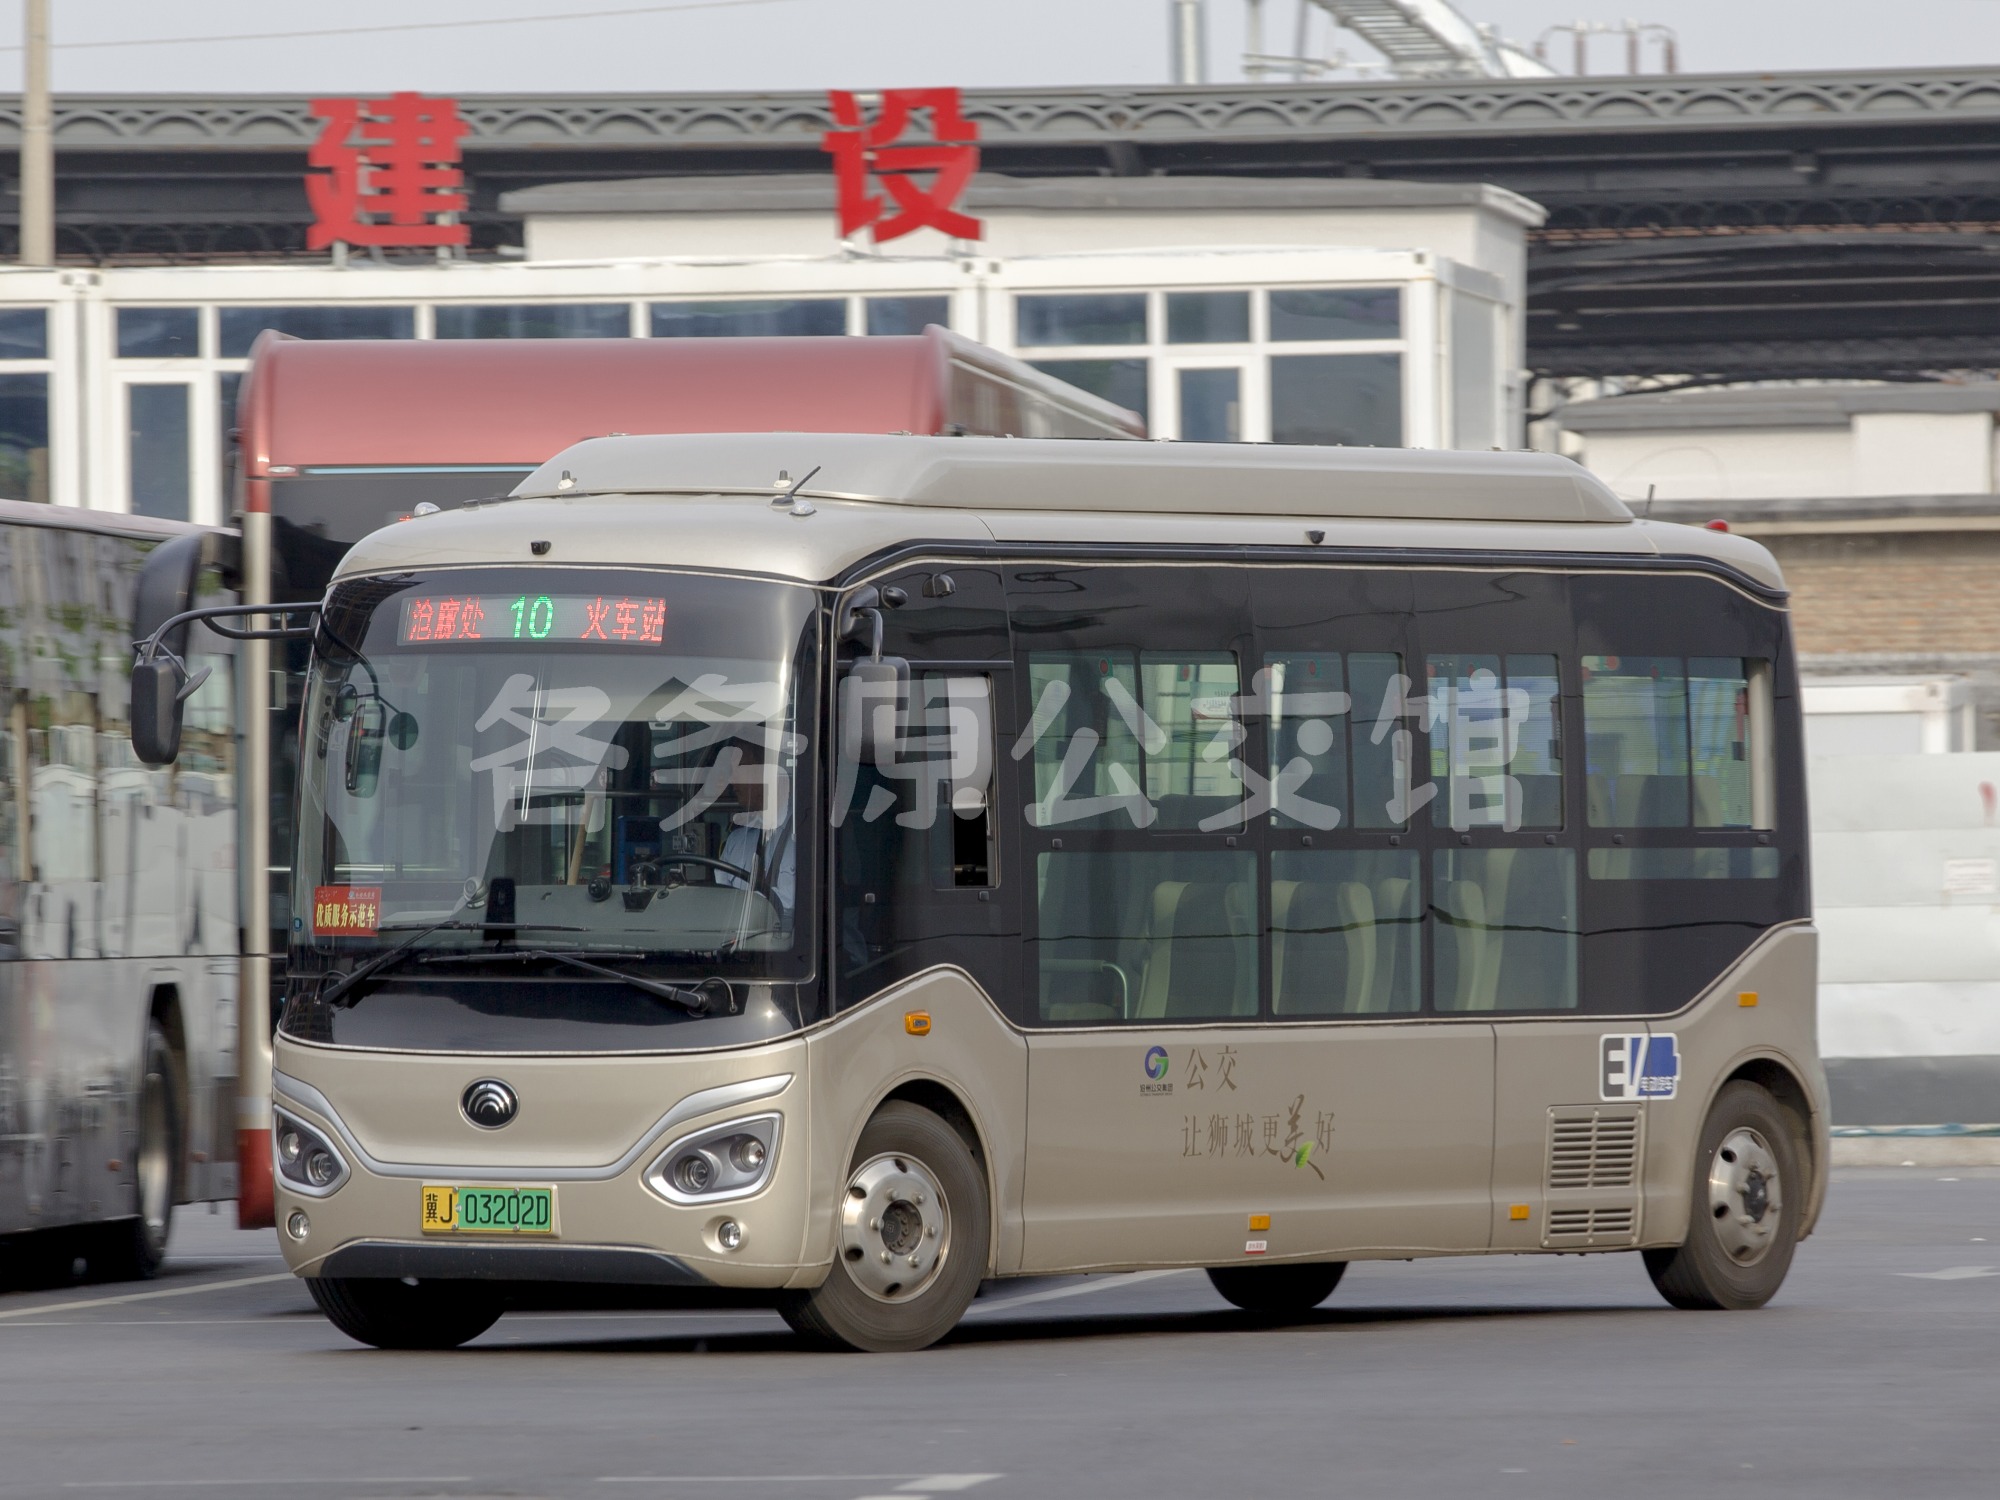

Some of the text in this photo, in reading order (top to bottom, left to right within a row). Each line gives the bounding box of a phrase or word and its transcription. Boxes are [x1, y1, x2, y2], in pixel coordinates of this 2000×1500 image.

[303, 87, 986, 251] 建 设
[510, 596, 554, 639] 10
[581, 597, 667, 642] 火车站
[316, 903, 376, 928] 优质服务示范车
[1184, 1045, 1238, 1092] 公交
[1602, 1035, 1650, 1098] EV
[1181, 1094, 1336, 1181] 让狮城更美好
